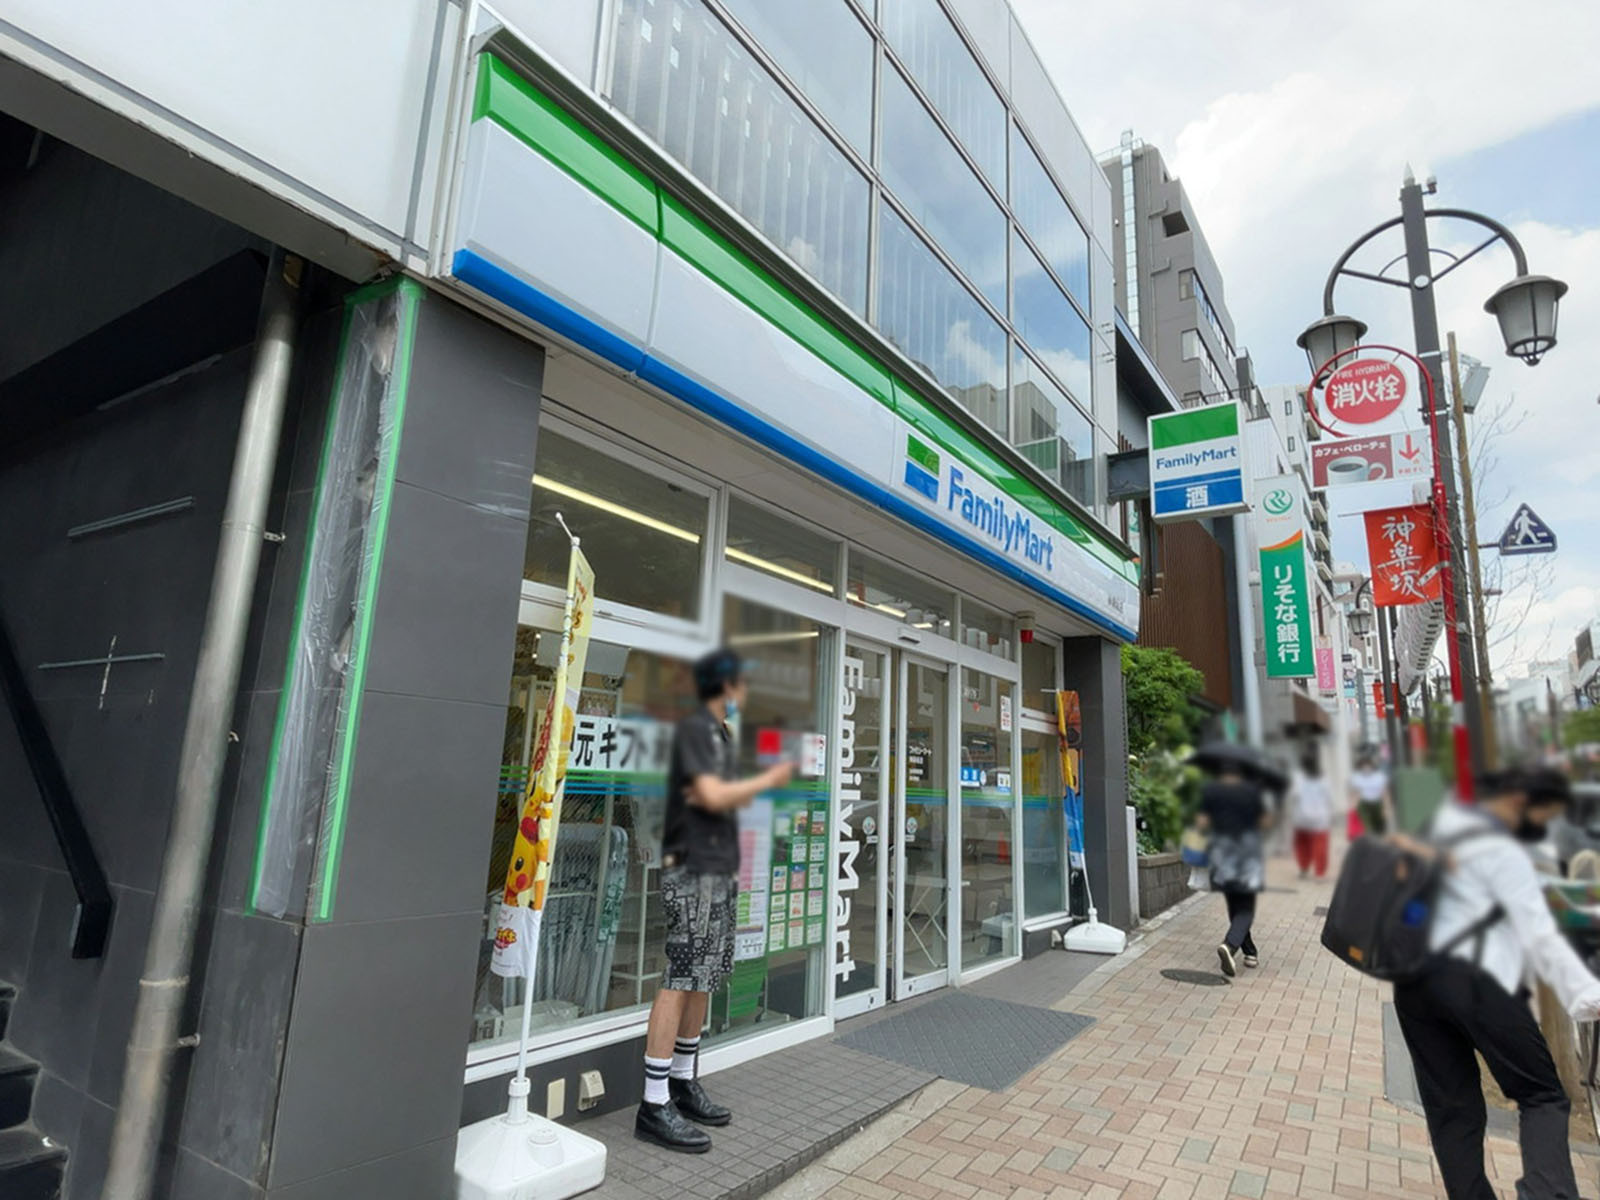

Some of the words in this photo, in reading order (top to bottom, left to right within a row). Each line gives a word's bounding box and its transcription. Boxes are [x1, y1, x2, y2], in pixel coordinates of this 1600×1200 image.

[1331, 374, 1400, 409] 消火栓
[1156, 445, 1238, 470] FamilyMart
[948, 465, 1054, 571] FamilyMart
[1186, 486, 1209, 508] 酒
[1376, 514, 1429, 599] 神楽坂
[1272, 564, 1300, 664] りそな銀行
